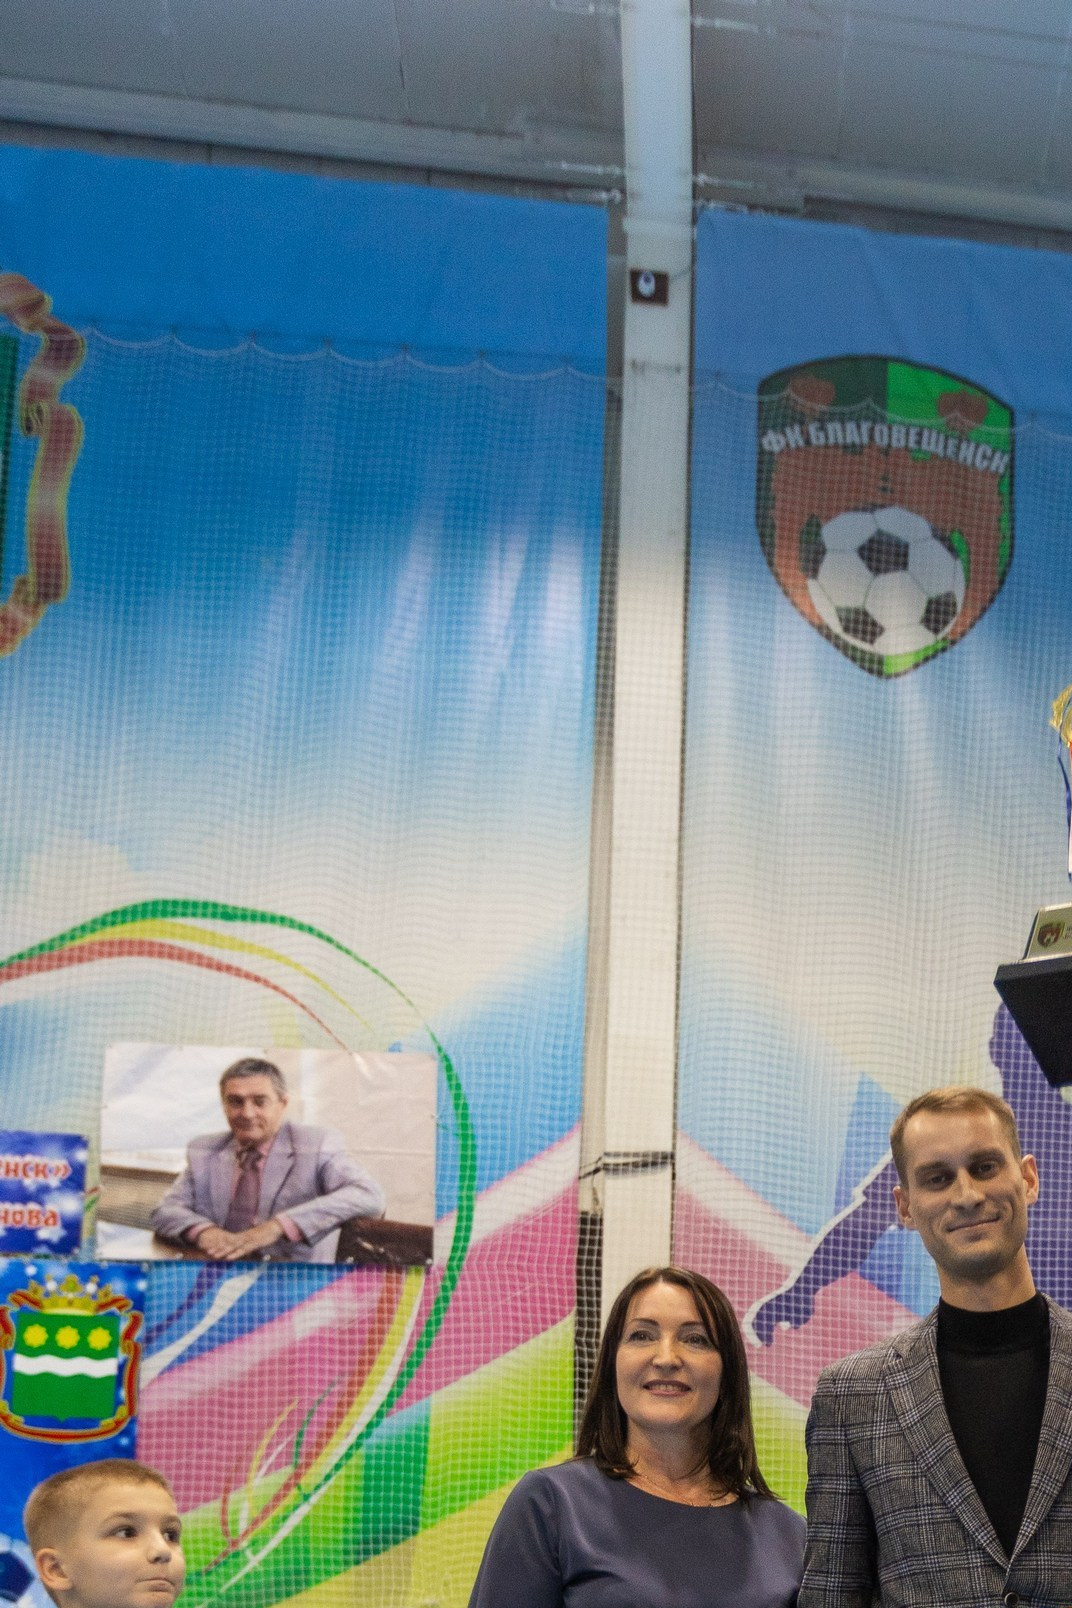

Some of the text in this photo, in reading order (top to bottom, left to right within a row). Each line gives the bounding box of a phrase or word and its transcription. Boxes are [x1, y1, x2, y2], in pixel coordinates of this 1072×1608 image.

[761, 420, 1010, 475] ФК БЛАГОВЕЩЕНСК
[0, 1158, 72, 1179] нск»
